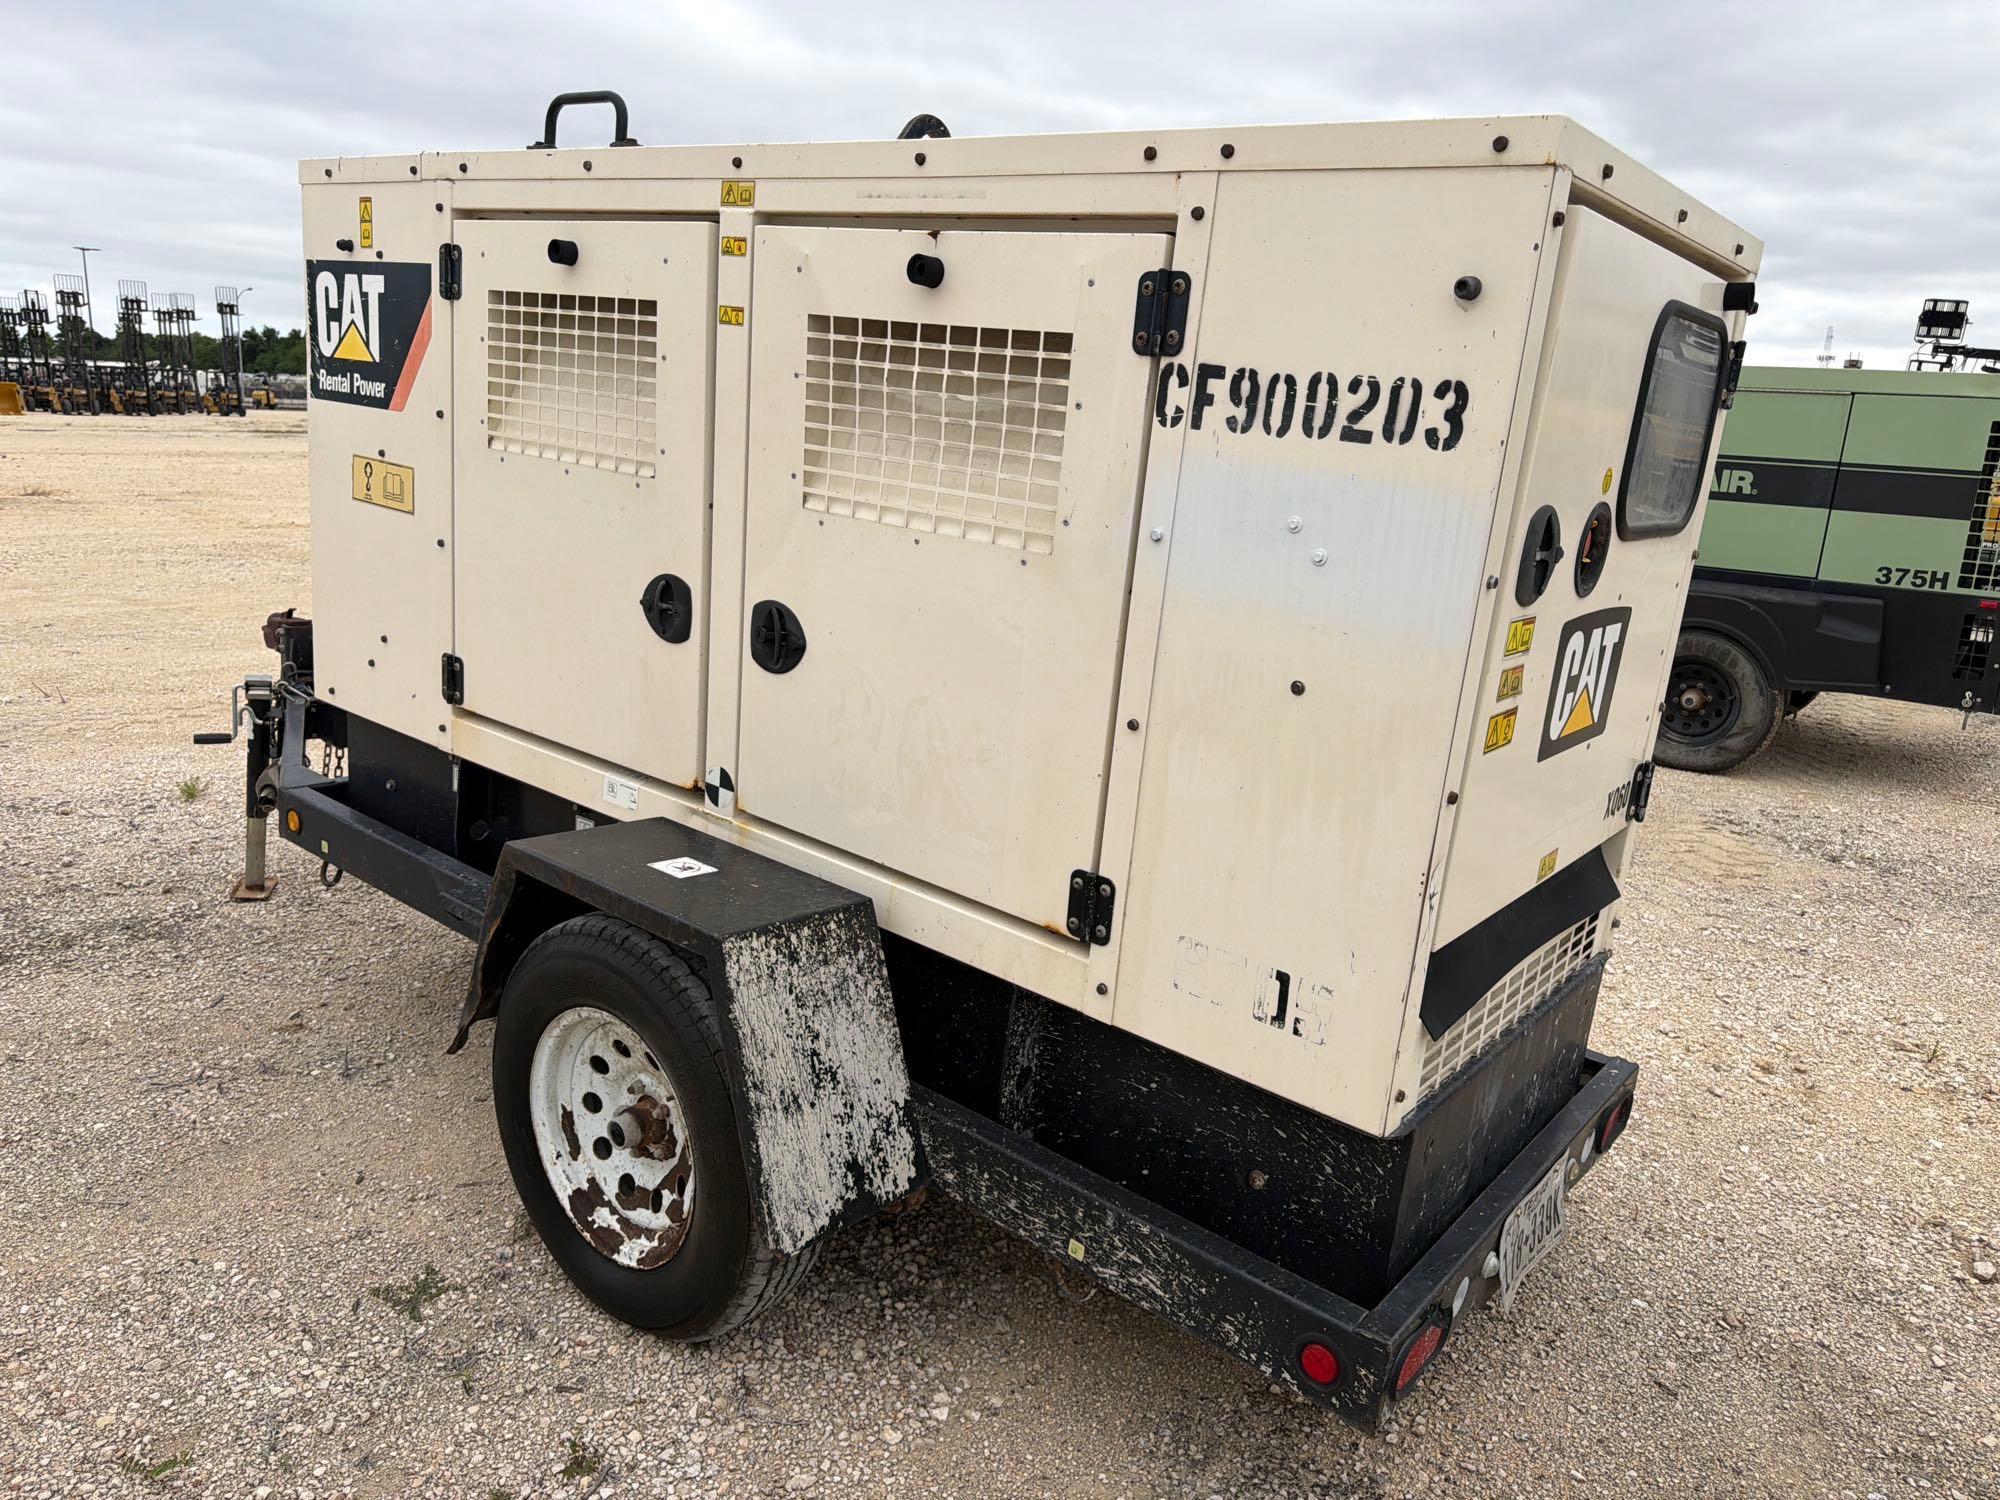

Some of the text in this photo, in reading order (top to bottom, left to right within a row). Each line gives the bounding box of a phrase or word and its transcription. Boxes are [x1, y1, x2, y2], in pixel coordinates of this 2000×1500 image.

[315, 270, 385, 363] CAT
[319, 368, 386, 399] Rental Power
[1155, 361, 1470, 452] CF900203
[1874, 566, 1950, 591] 375H
[1549, 622, 1623, 741] CAT
